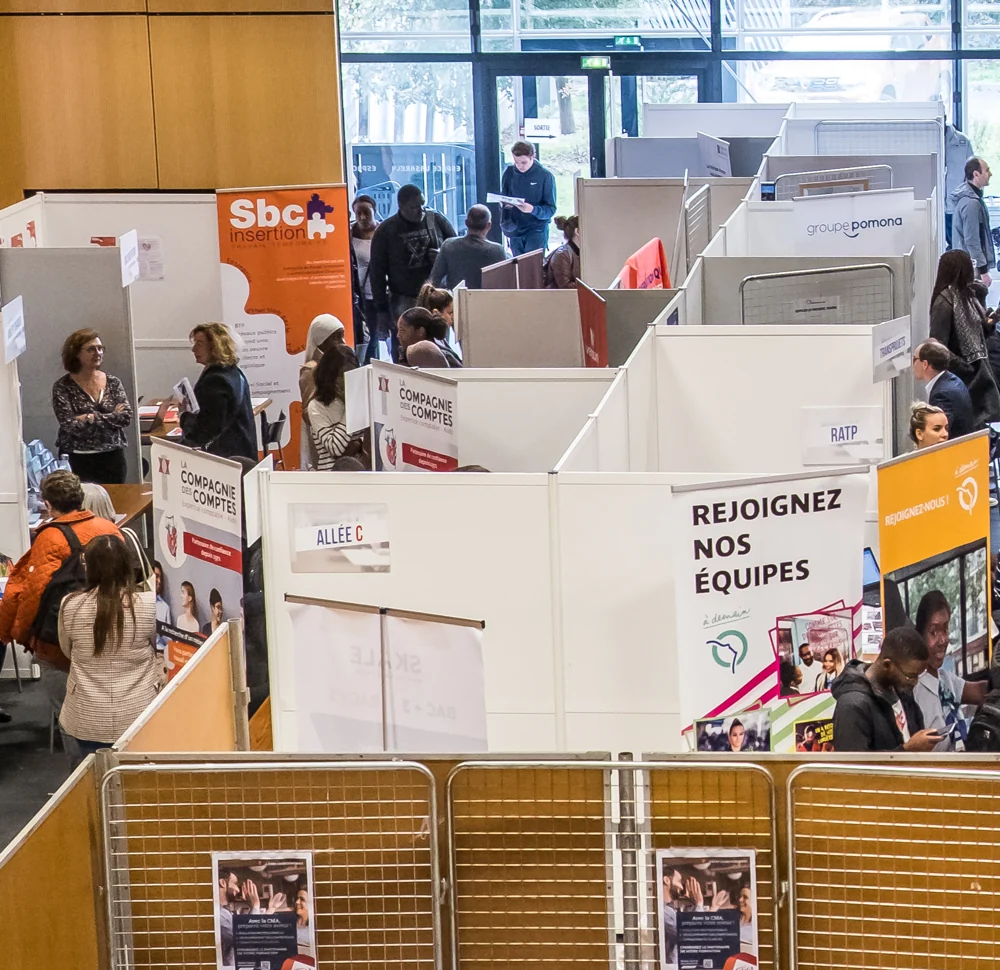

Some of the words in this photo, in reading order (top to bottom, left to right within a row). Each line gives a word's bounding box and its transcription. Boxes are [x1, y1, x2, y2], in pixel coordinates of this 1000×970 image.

[229, 198, 305, 229] Sbc
[807, 222, 850, 236] groupe
[851, 217, 903, 231] pomona
[229, 226, 306, 243] insertion
[399, 387, 453, 413] COMPAGNIE
[411, 404, 453, 427] COMPTES
[830, 424, 858, 443] RATP
[180, 470, 236, 500] COMPAGNIE
[192, 489, 237, 516] COMPTES
[692, 488, 843, 527] REJOIGNEZ
[884, 496, 946, 527] REJOIGNEZ-NOUS
[316, 523, 353, 546] ALLÉE
[355, 524, 364, 542] C
[693, 533, 752, 561] NOS
[694, 558, 811, 596] ÉQUIPES
